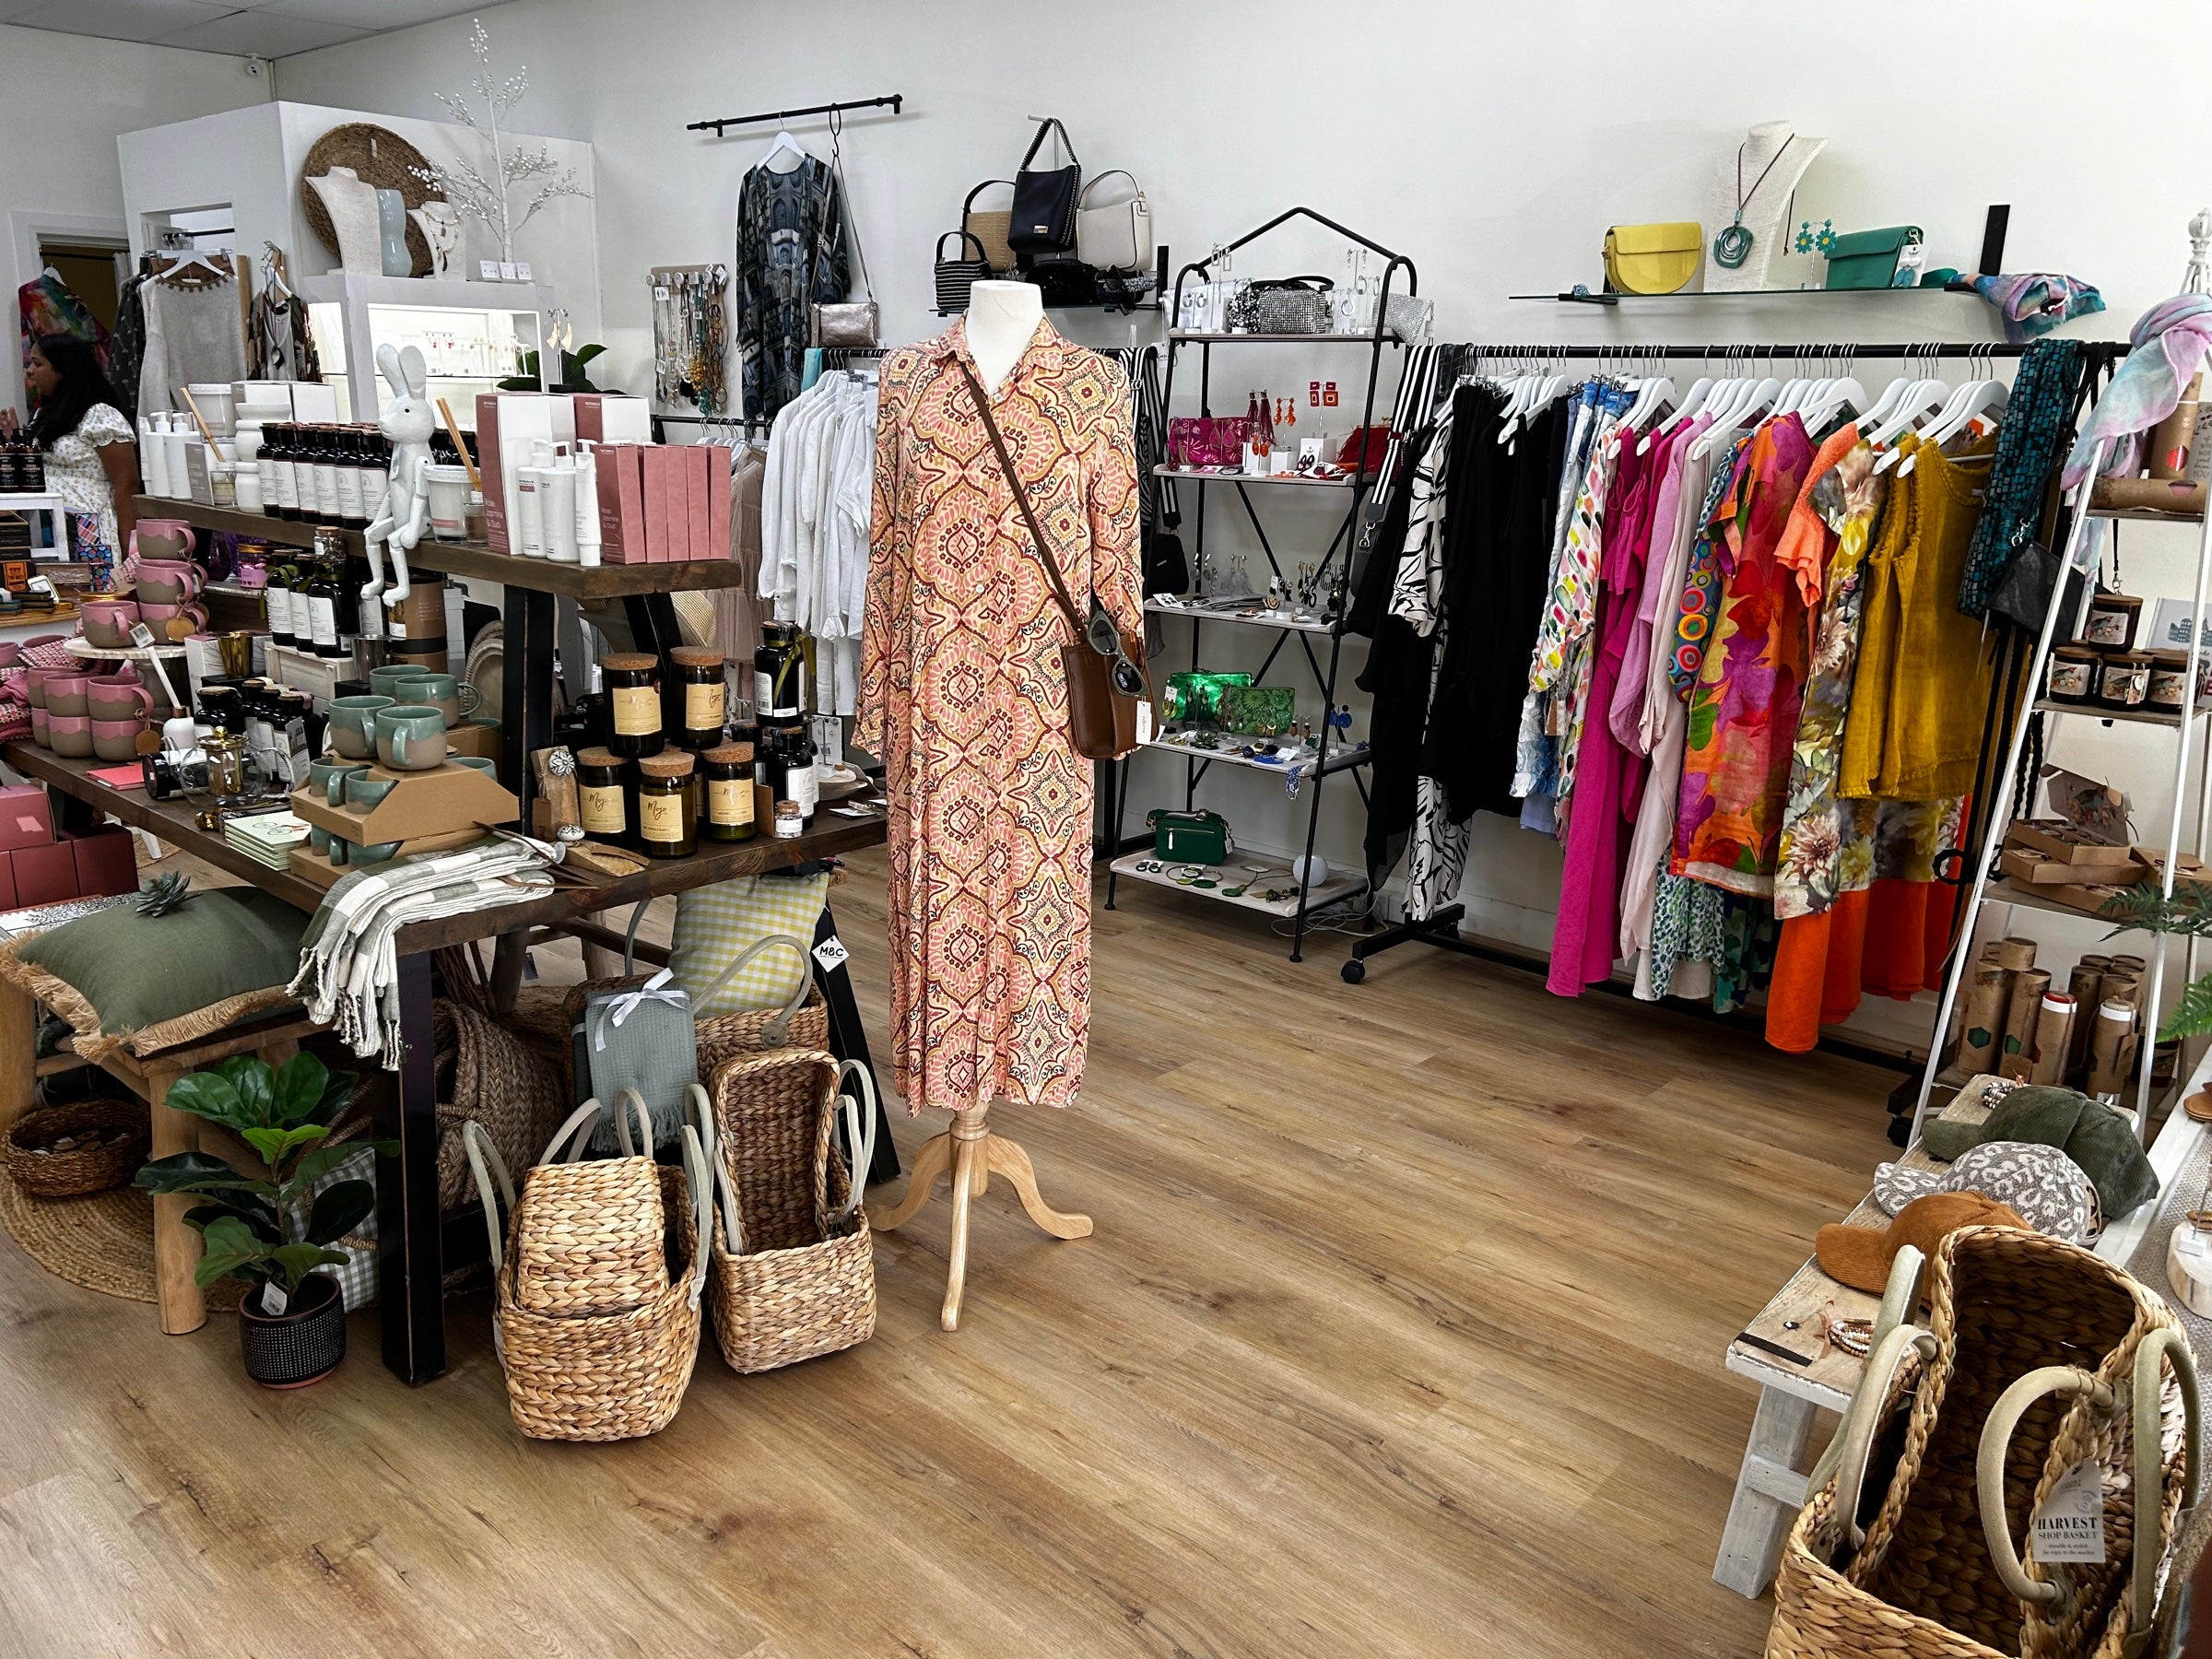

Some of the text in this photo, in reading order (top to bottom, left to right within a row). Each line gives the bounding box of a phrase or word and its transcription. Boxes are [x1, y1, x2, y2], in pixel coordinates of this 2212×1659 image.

[819, 946, 844, 957] M&C
[2038, 1517, 2097, 1530] HARVEST
[2038, 1531, 2098, 1539] SHOP BASKET
